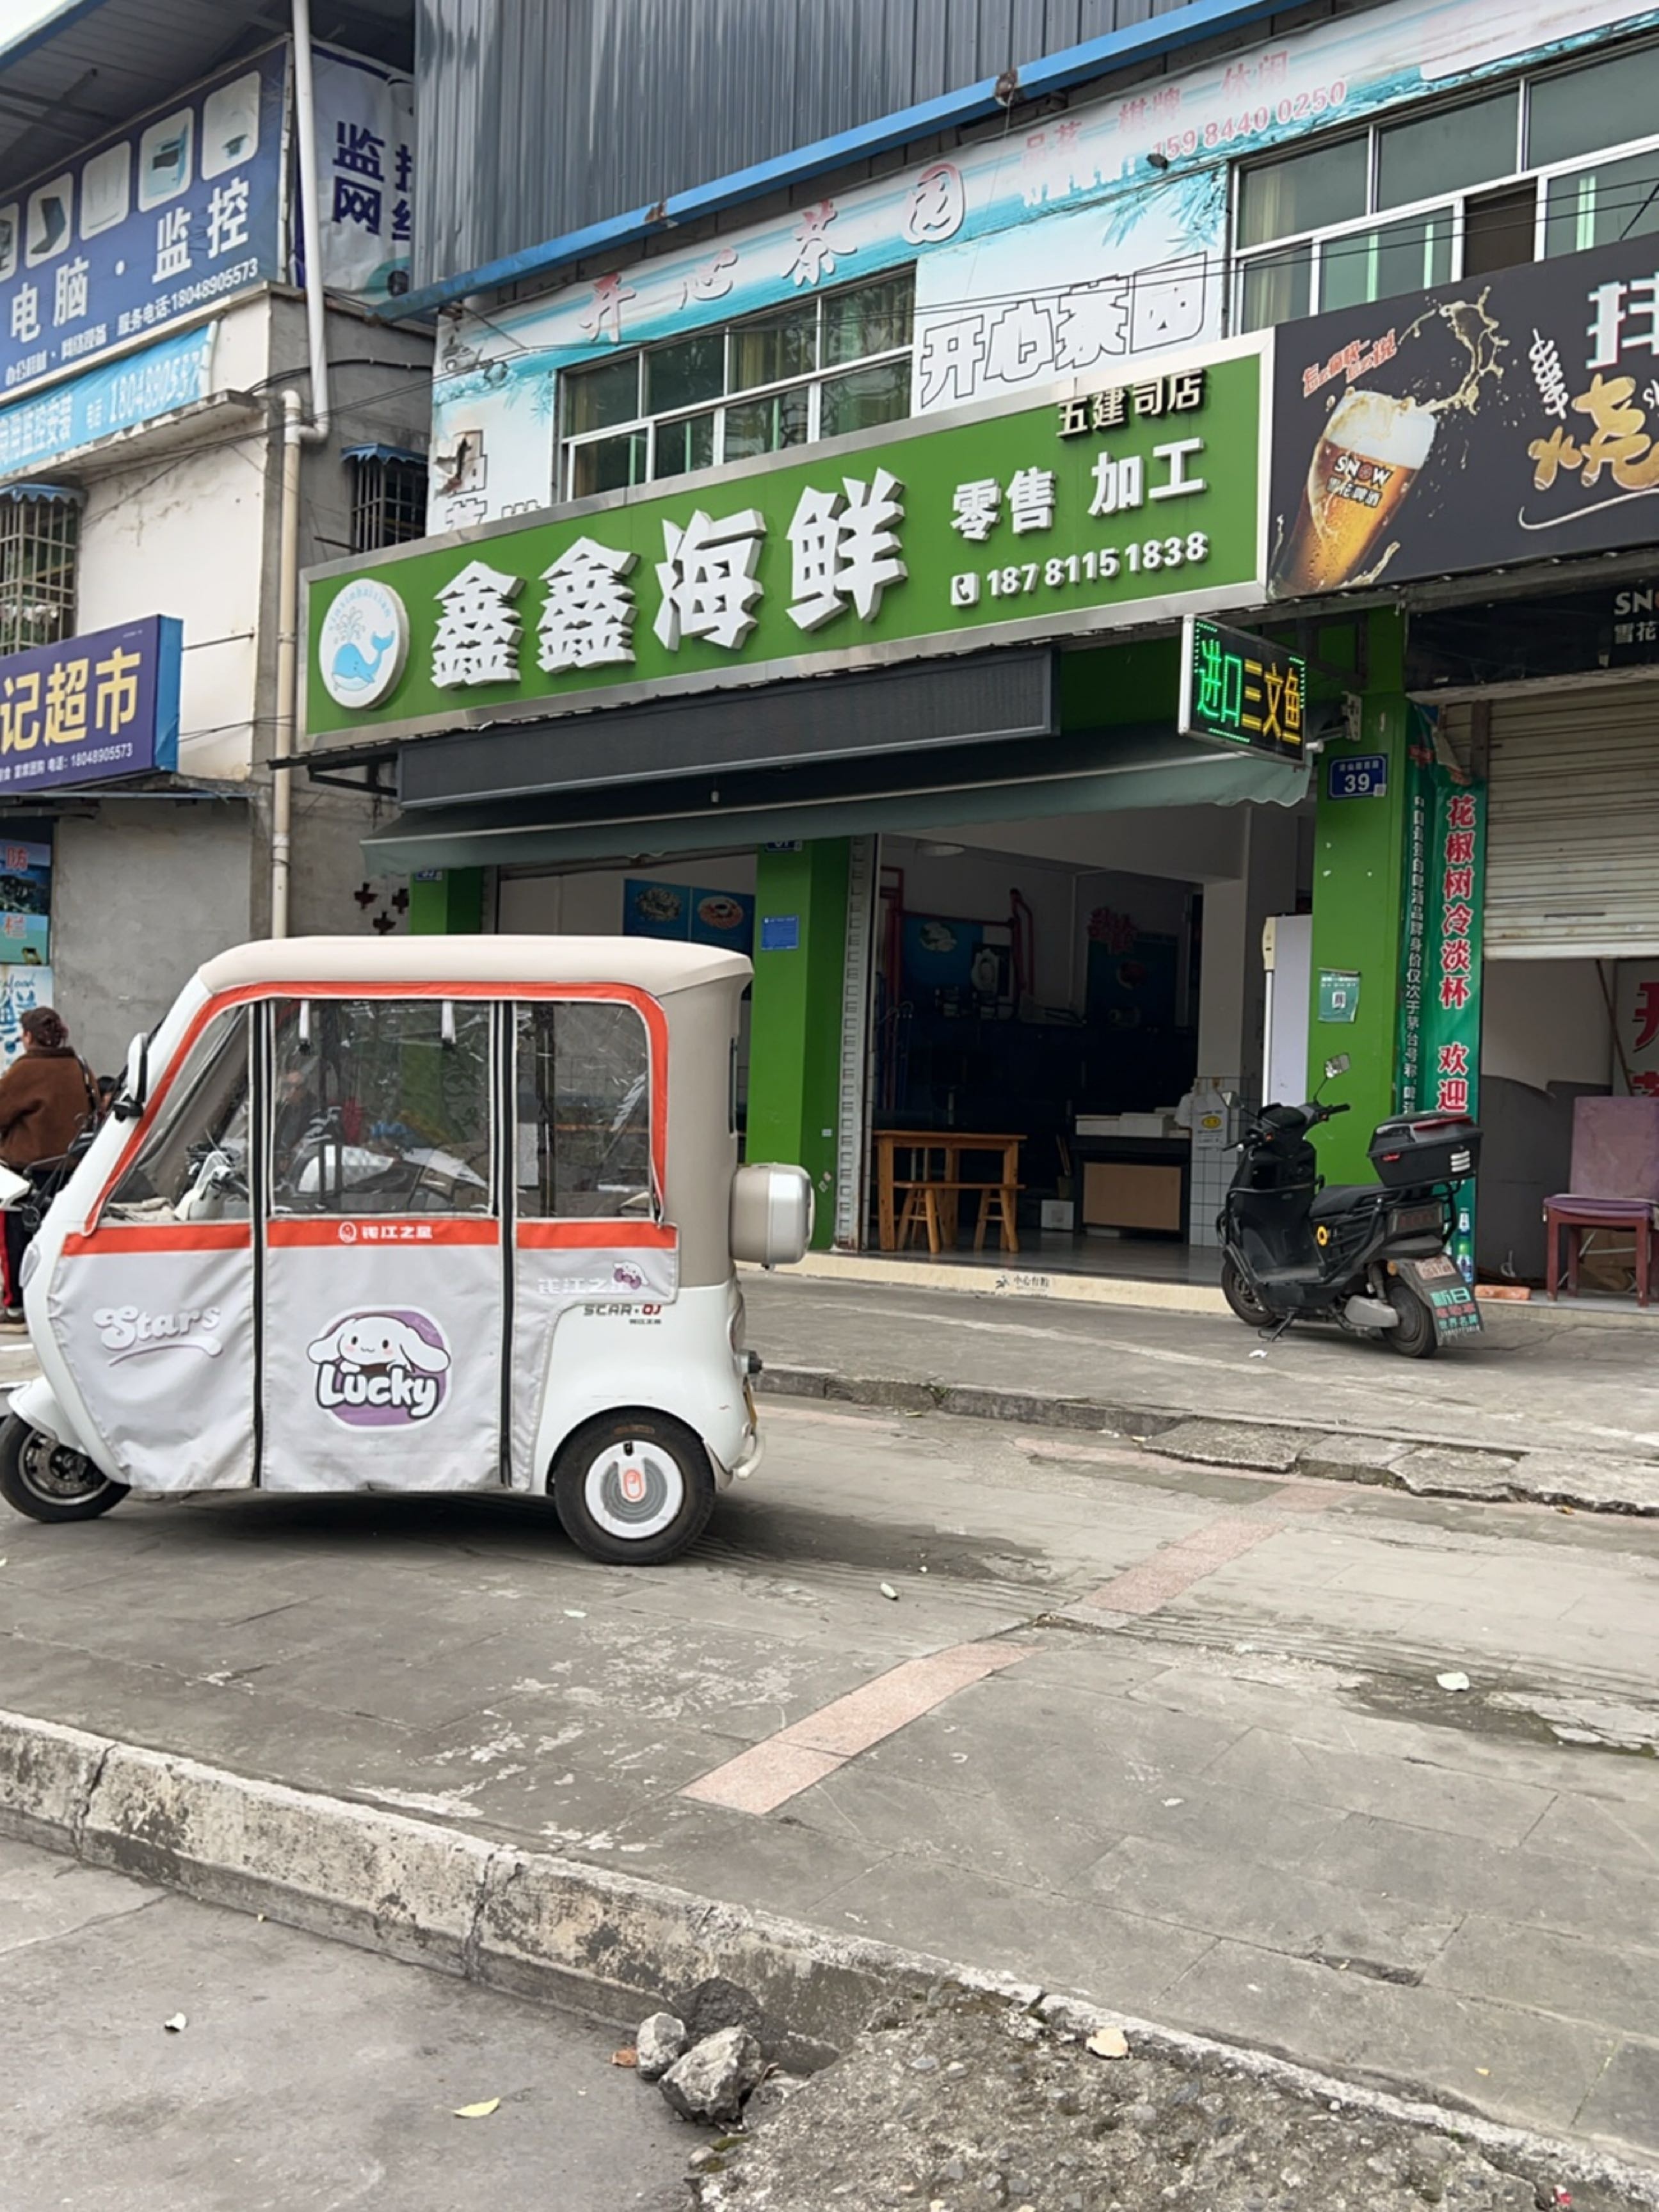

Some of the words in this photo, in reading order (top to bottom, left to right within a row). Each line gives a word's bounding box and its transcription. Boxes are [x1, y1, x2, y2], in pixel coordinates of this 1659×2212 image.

[1205, 109, 1269, 147] 8440
[1278, 81, 1347, 124] 0250
[921, 251, 1208, 409] 开心茶园
[1057, 369, 1203, 438] 五建司店
[950, 466, 1056, 540] 零售
[1088, 437, 1206, 517] 加工
[1334, 455, 1393, 486] SNOW
[431, 467, 908, 690] 鑫鑫海鲜
[986, 563, 1038, 596] 187
[1045, 548, 1121, 587] 8115
[1125, 532, 1208, 572] 1838
[0, 646, 141, 755] 记超市
[1198, 639, 1301, 745] 进口三文鱼
[1345, 773, 1370, 793] 39
[1440, 794, 1476, 1009] 花椒树冷淡杯
[1438, 1041, 1469, 1112] 欢迎
[93, 1305, 221, 1350] Stars
[317, 1361, 439, 1418] Lucky
